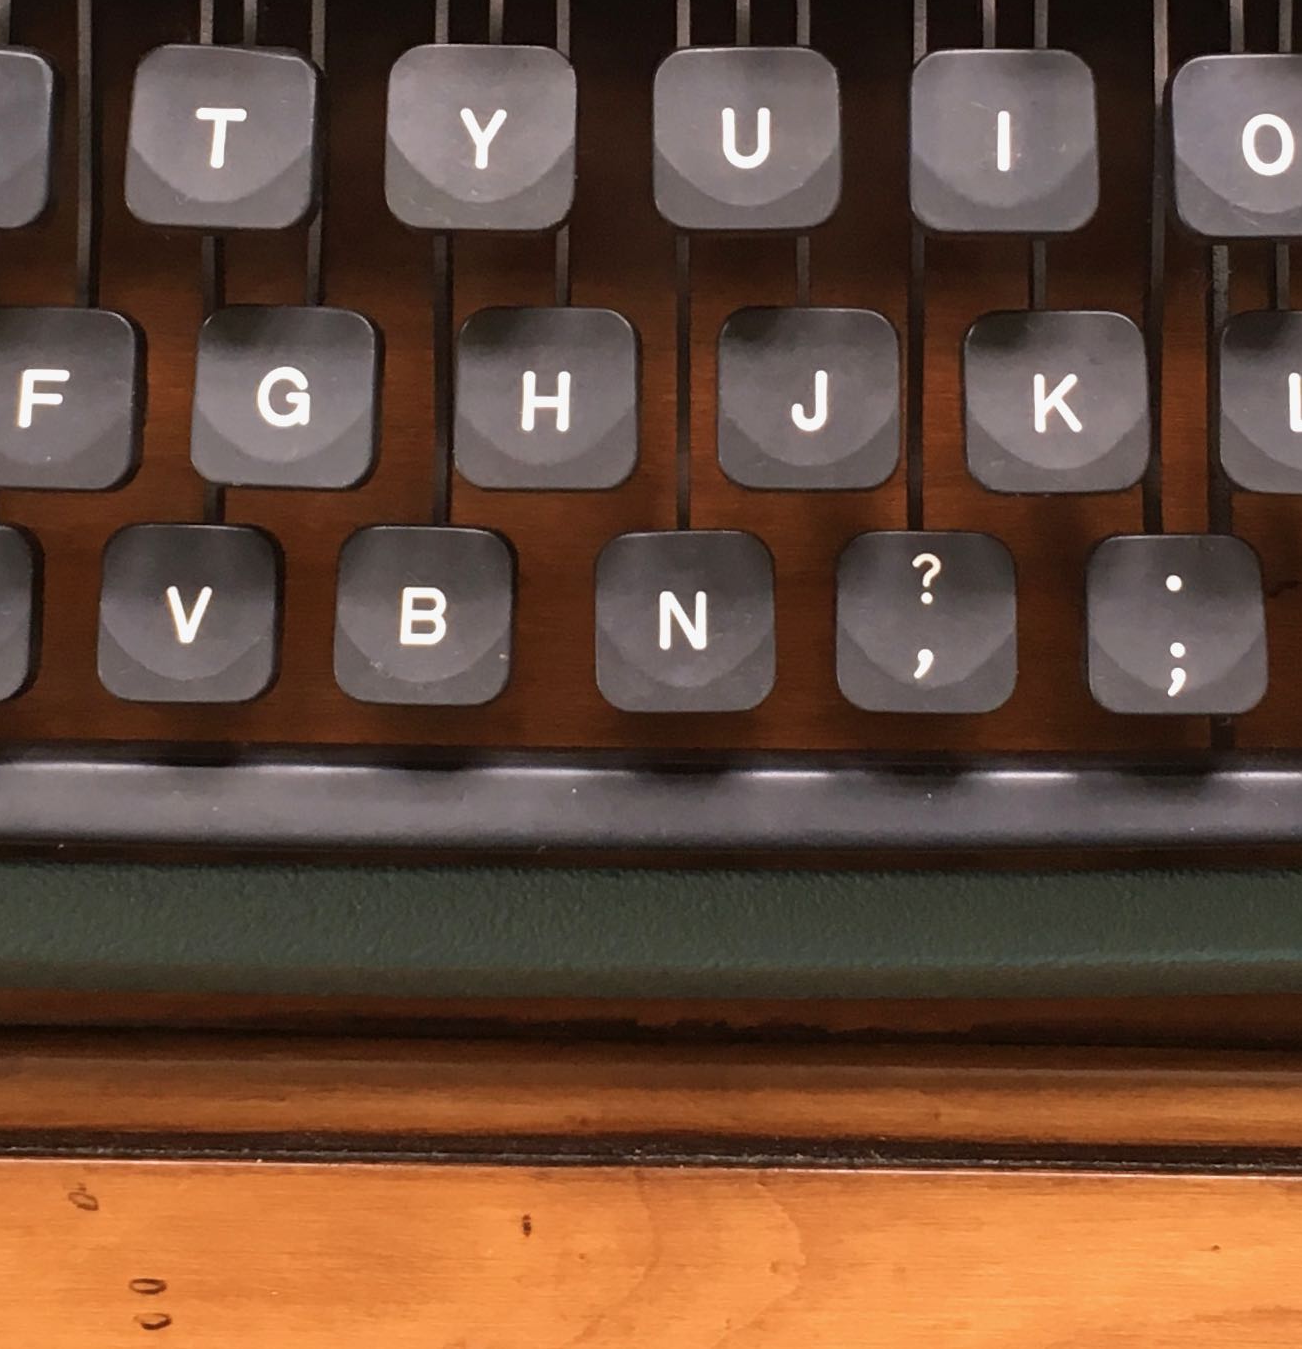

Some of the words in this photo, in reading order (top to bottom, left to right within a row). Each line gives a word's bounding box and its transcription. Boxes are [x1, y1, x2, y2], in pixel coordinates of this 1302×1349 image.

[195, 107, 247, 169] T
[460, 107, 508, 170] Y
[721, 107, 771, 170] U
[997, 110, 1011, 172] I
[1241, 113, 1295, 176] O
[17, 368, 70, 429] F
[257, 366, 311, 428] G
[521, 370, 571, 432] H
[791, 370, 828, 432] J
[1033, 373, 1083, 433] K
[912, 553, 941, 605] ?
[166, 586, 213, 644] V
[399, 586, 447, 646] B
[659, 591, 708, 651] N
[1167, 642, 1187, 697] ;
